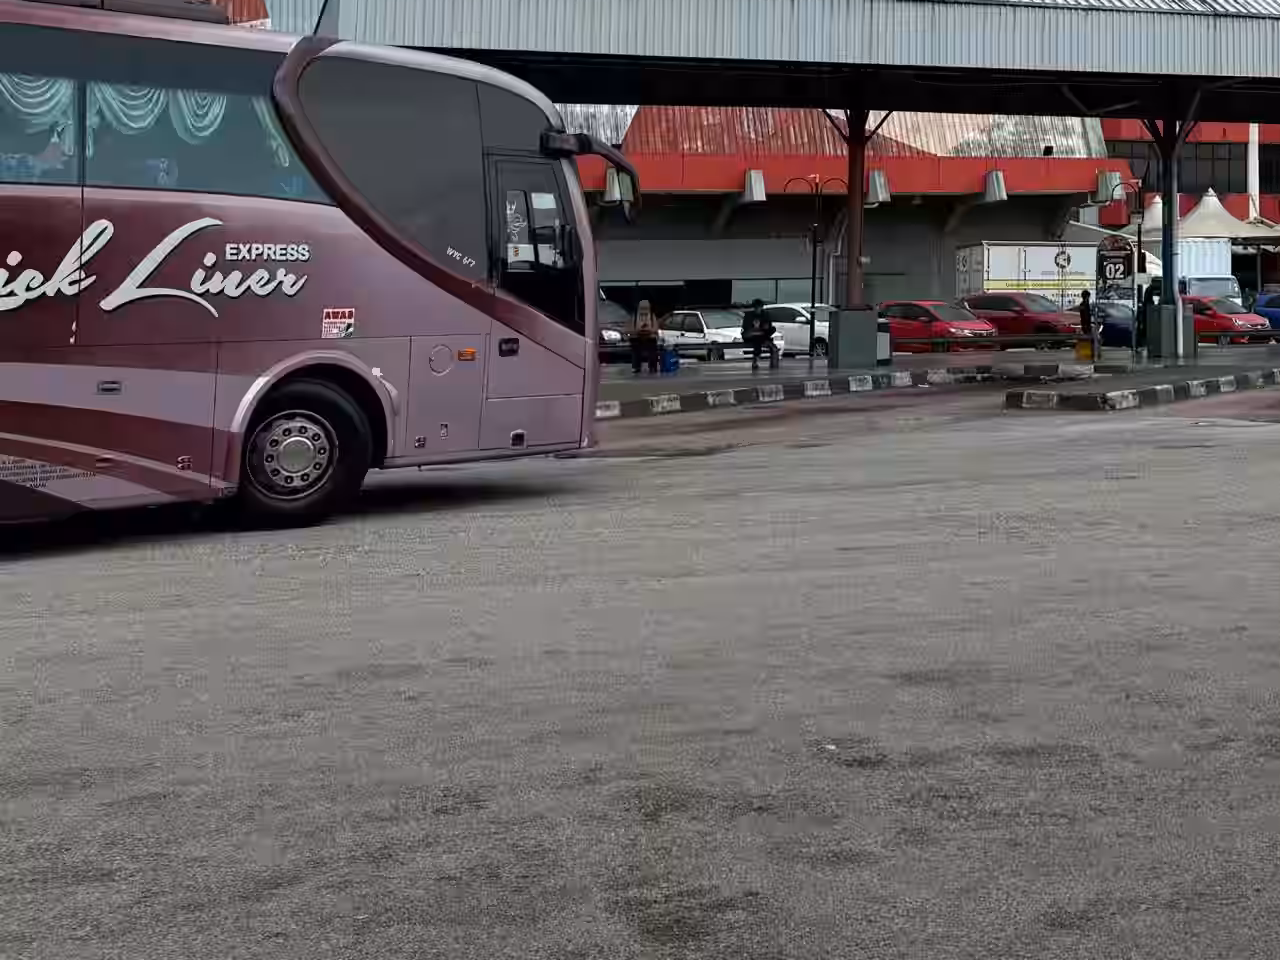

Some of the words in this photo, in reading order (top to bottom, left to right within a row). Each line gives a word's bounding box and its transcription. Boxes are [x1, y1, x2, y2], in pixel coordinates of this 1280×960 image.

[225, 243, 310, 261] EXPRESS
[99, 217, 308, 318] Liner
[1105, 263, 1125, 279] 02
